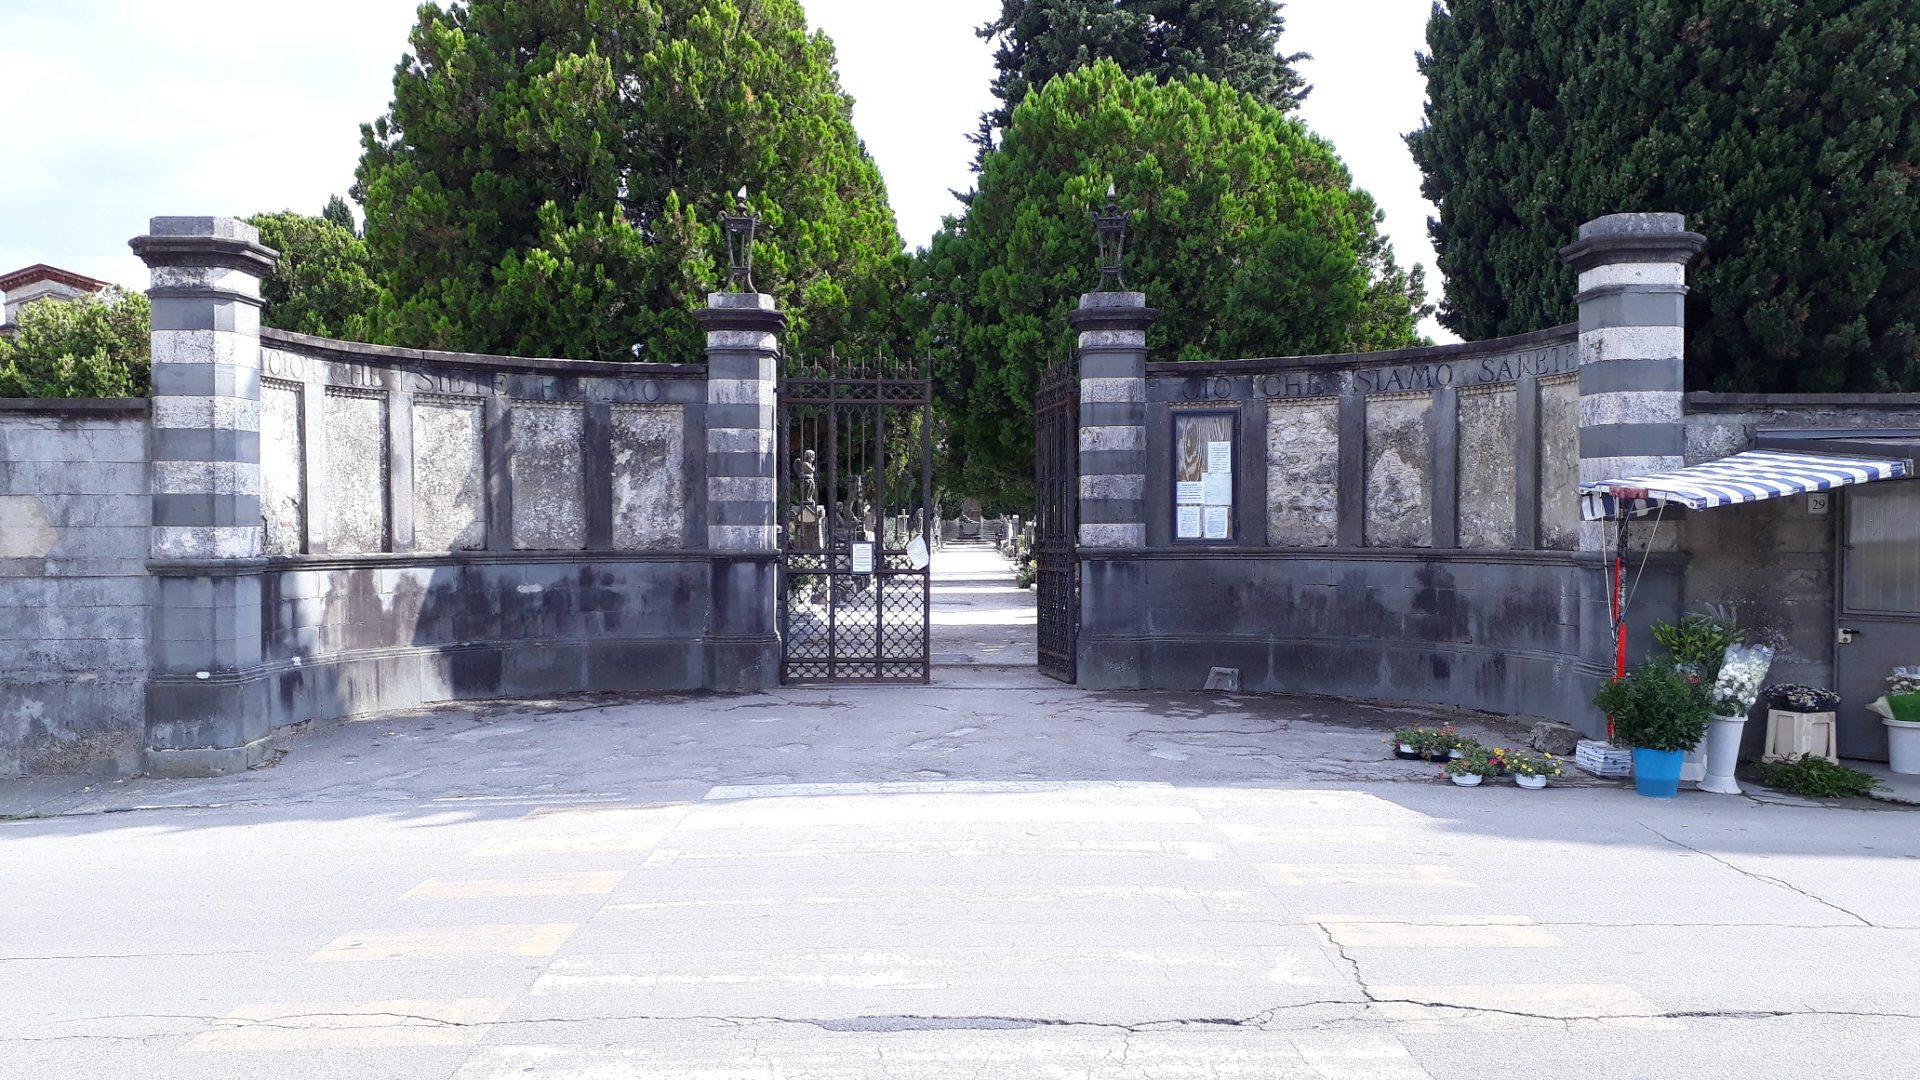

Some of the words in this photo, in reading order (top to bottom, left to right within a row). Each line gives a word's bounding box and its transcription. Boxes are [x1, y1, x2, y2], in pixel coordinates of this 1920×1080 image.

[1262, 375, 1323, 396] CHE
[1354, 363, 1453, 392] SIAMO
[1478, 345, 1577, 383] SARETE
[1812, 499, 1826, 510] 29
